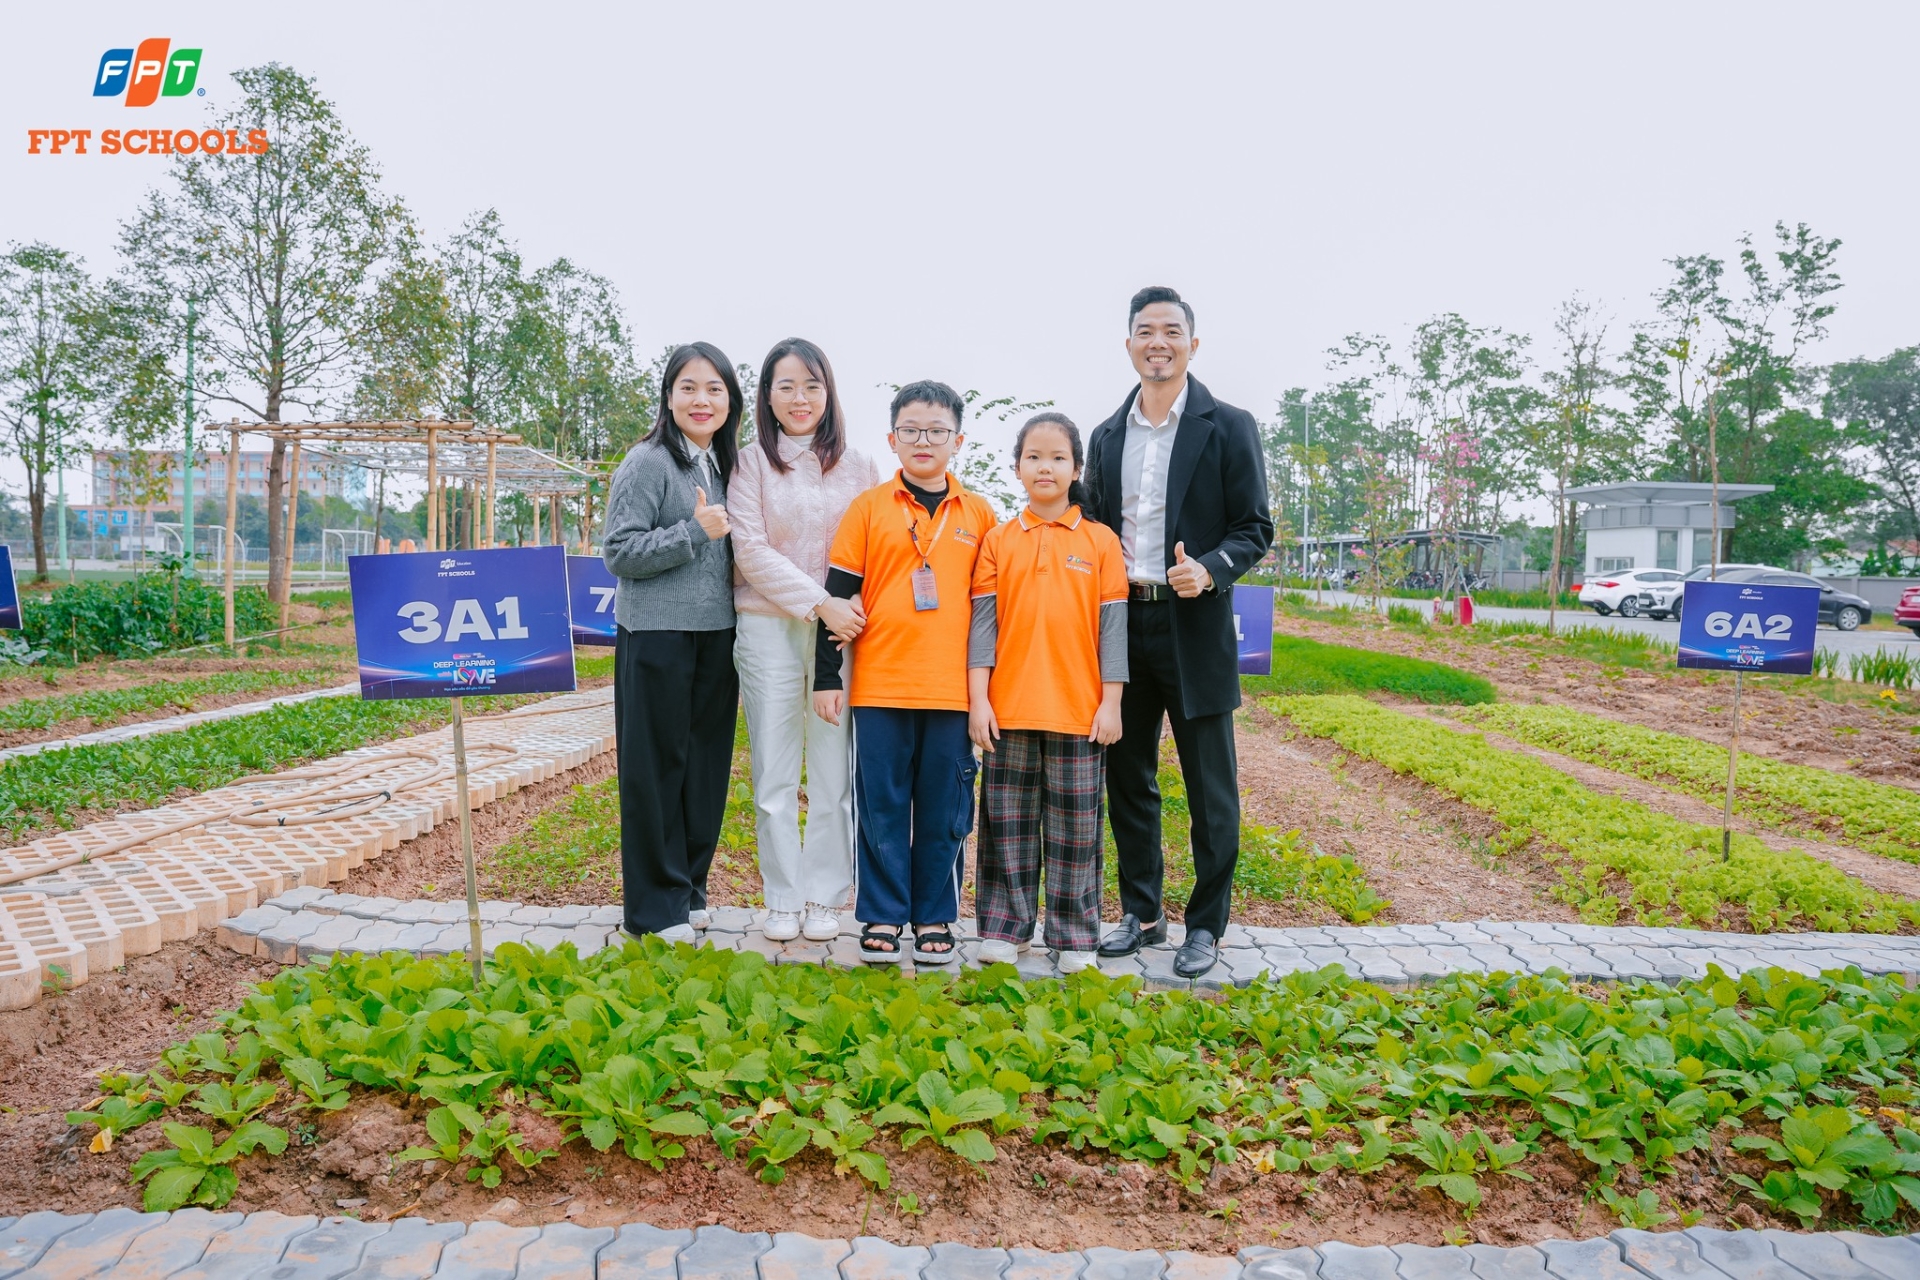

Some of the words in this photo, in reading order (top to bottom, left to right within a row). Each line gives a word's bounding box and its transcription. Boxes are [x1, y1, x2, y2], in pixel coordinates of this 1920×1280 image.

[590, 586, 616, 614] 7
[397, 596, 529, 644] 3A1
[1704, 611, 1793, 641] 6A2
[433, 661, 454, 669] DEEP
[455, 659, 496, 668] LEARNING
[453, 667, 496, 685] LOVE
